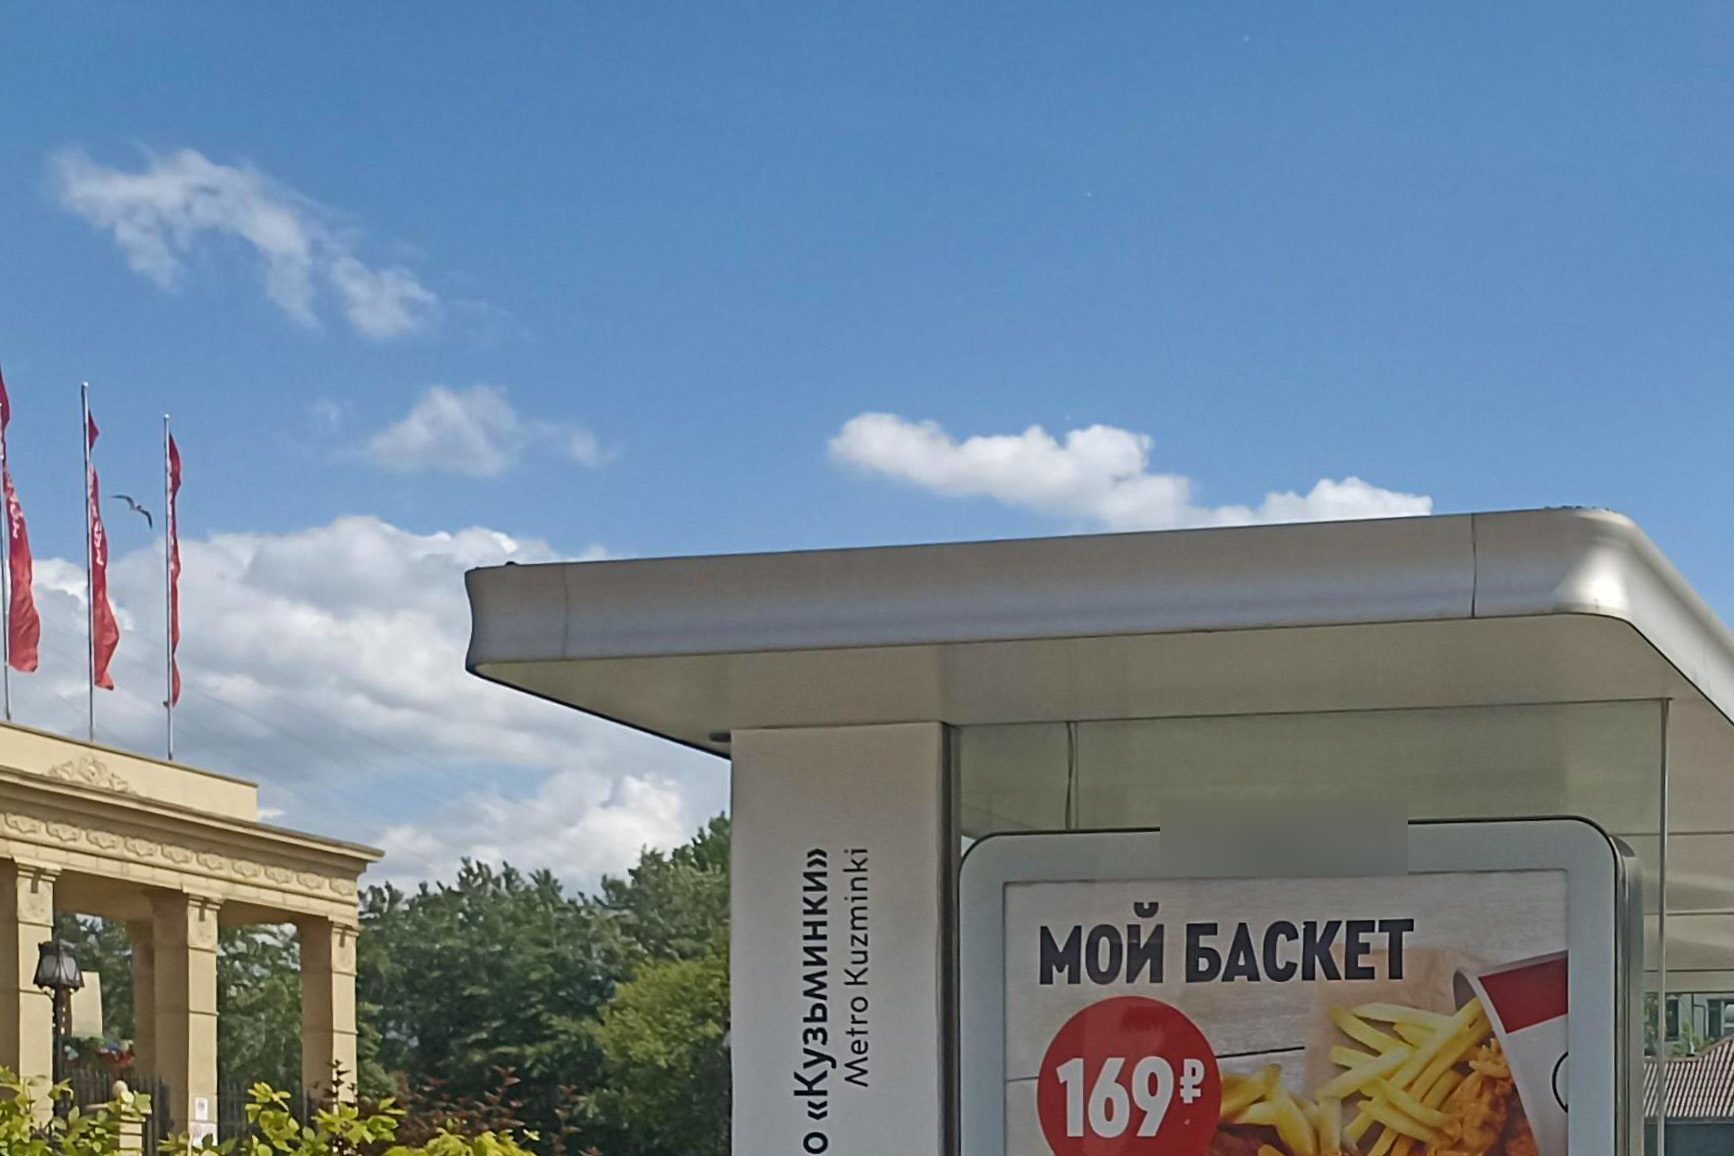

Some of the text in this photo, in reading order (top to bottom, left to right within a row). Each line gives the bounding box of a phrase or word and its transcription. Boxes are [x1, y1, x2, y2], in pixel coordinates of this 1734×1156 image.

[793, 847, 837, 1122] «Кузьминки»
[844, 847, 869, 1088] Metro Kuzminki
[1039, 901, 1415, 986] МОЙ БАСКЕТ
